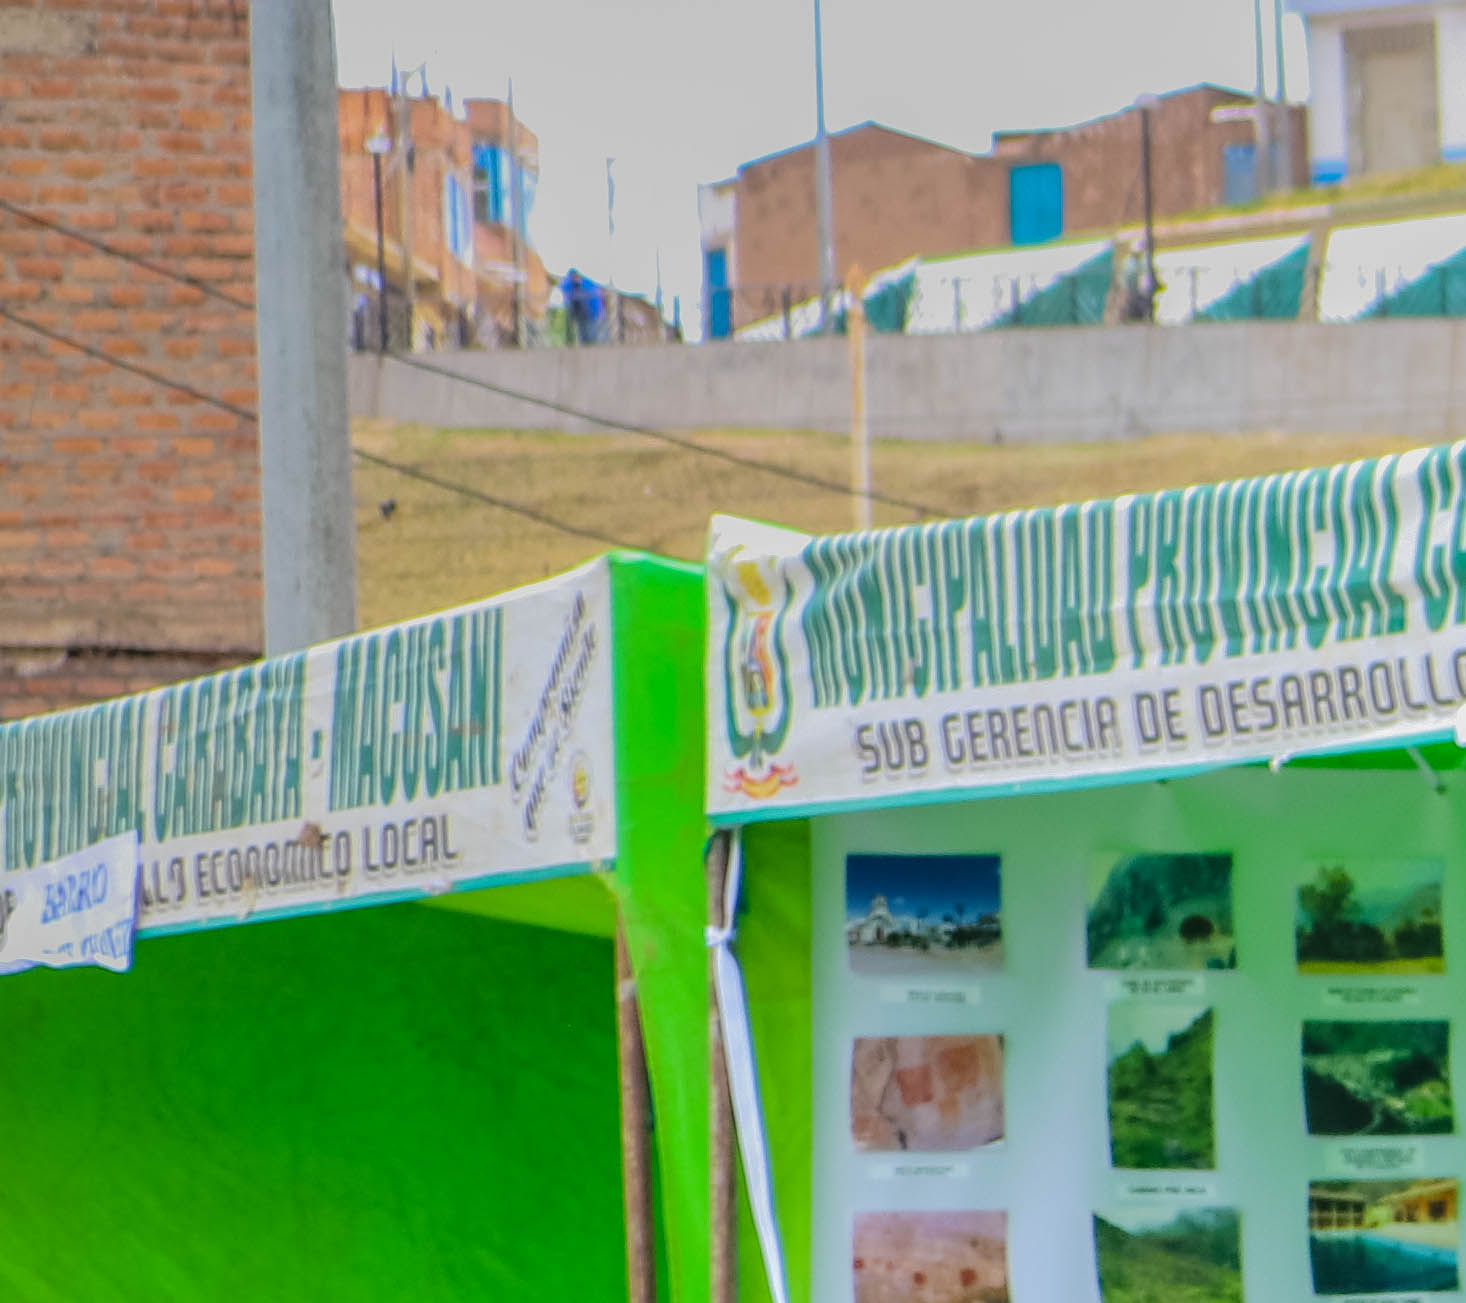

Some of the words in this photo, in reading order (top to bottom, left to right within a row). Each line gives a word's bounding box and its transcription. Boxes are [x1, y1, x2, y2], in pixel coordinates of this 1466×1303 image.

[801, 499, 1117, 708] MUNICIPALIDAD
[1126, 454, 1408, 670] PROVINCIAL
[155, 652, 306, 842] CARABAYA
[329, 607, 503, 812] MACUSANI
[855, 717, 928, 776] SUB
[940, 697, 1117, 766] GERENCIA
[1134, 685, 1185, 744] DE
[194, 830, 351, 898] ECONOMICO
[362, 813, 457, 873] LOCAL
